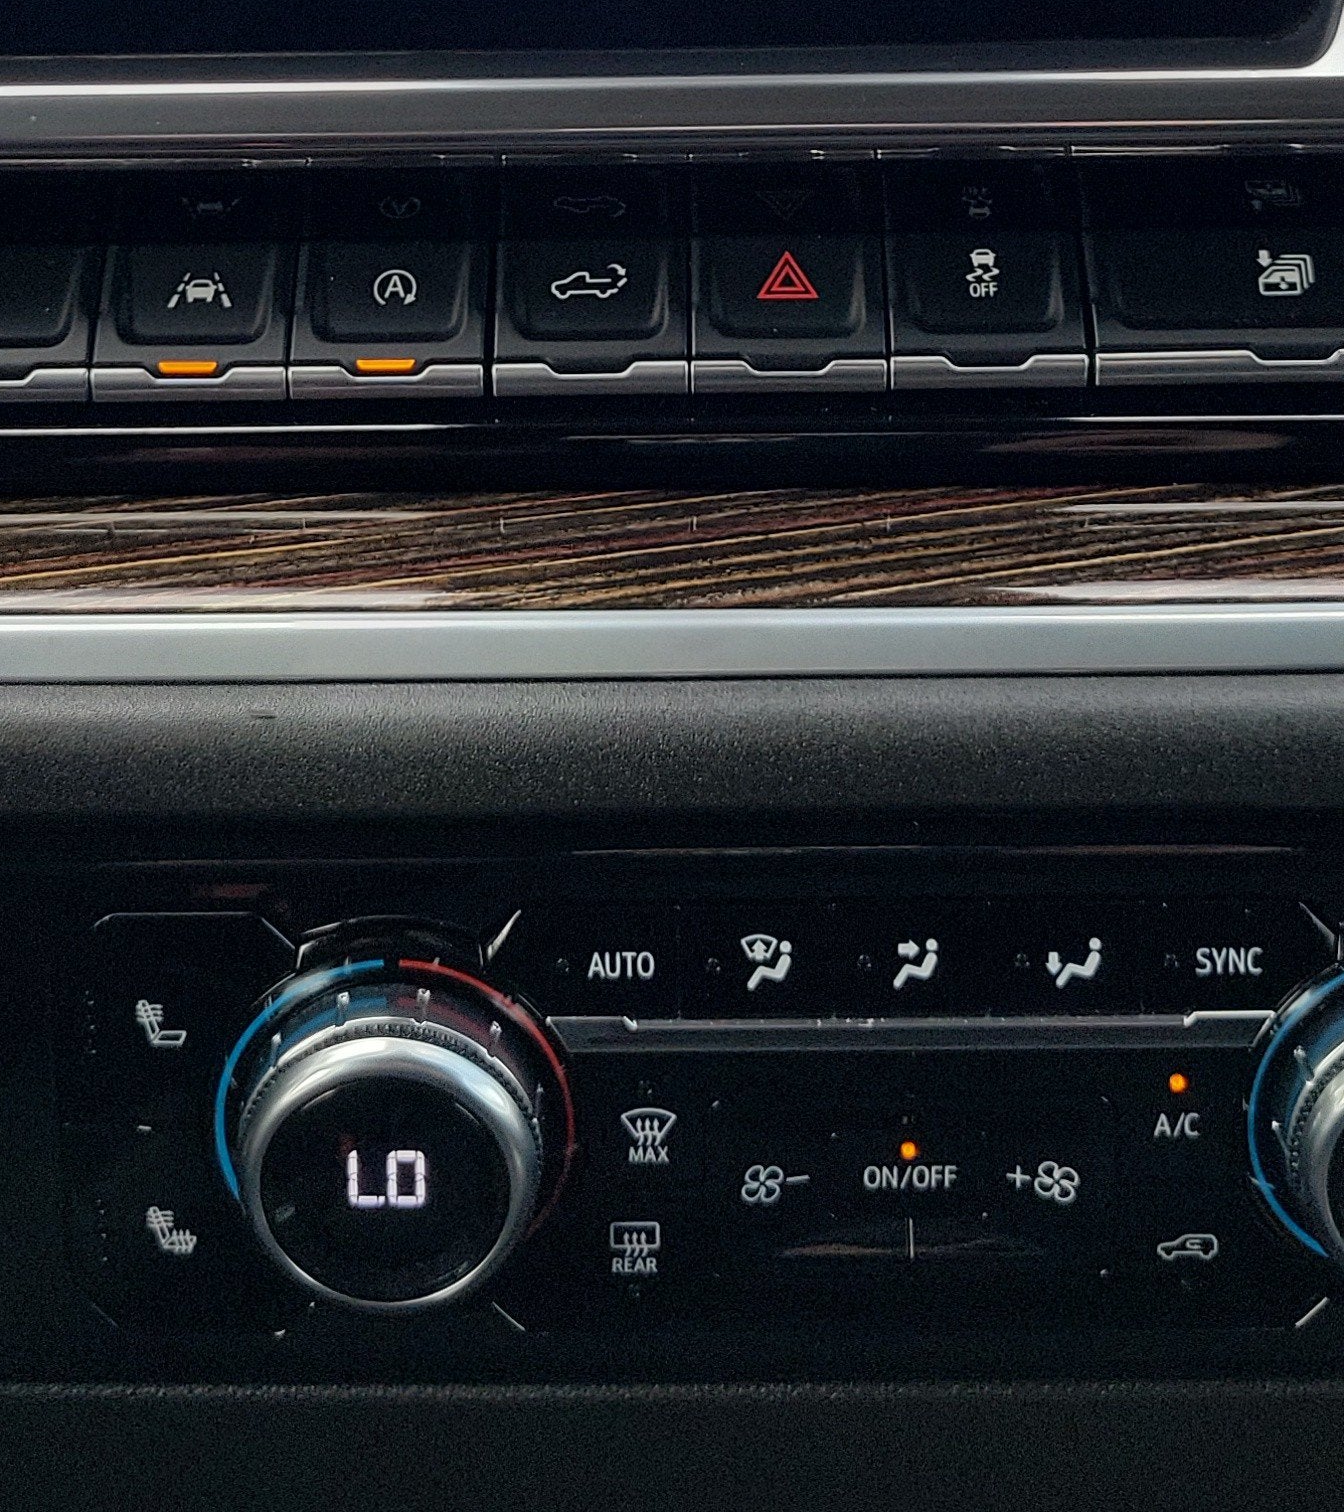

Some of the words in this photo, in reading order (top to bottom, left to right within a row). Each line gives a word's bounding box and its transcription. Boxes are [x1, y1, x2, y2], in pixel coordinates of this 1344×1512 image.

[969, 282, 998, 298] OFF
[588, 951, 655, 980] AUTO
[1195, 947, 1264, 977] SYNC
[1155, 1112, 1200, 1138] A/C
[628, 1146, 670, 1163] MAX
[863, 1165, 957, 1191] ON/OFF
[611, 1257, 657, 1274] REAR
